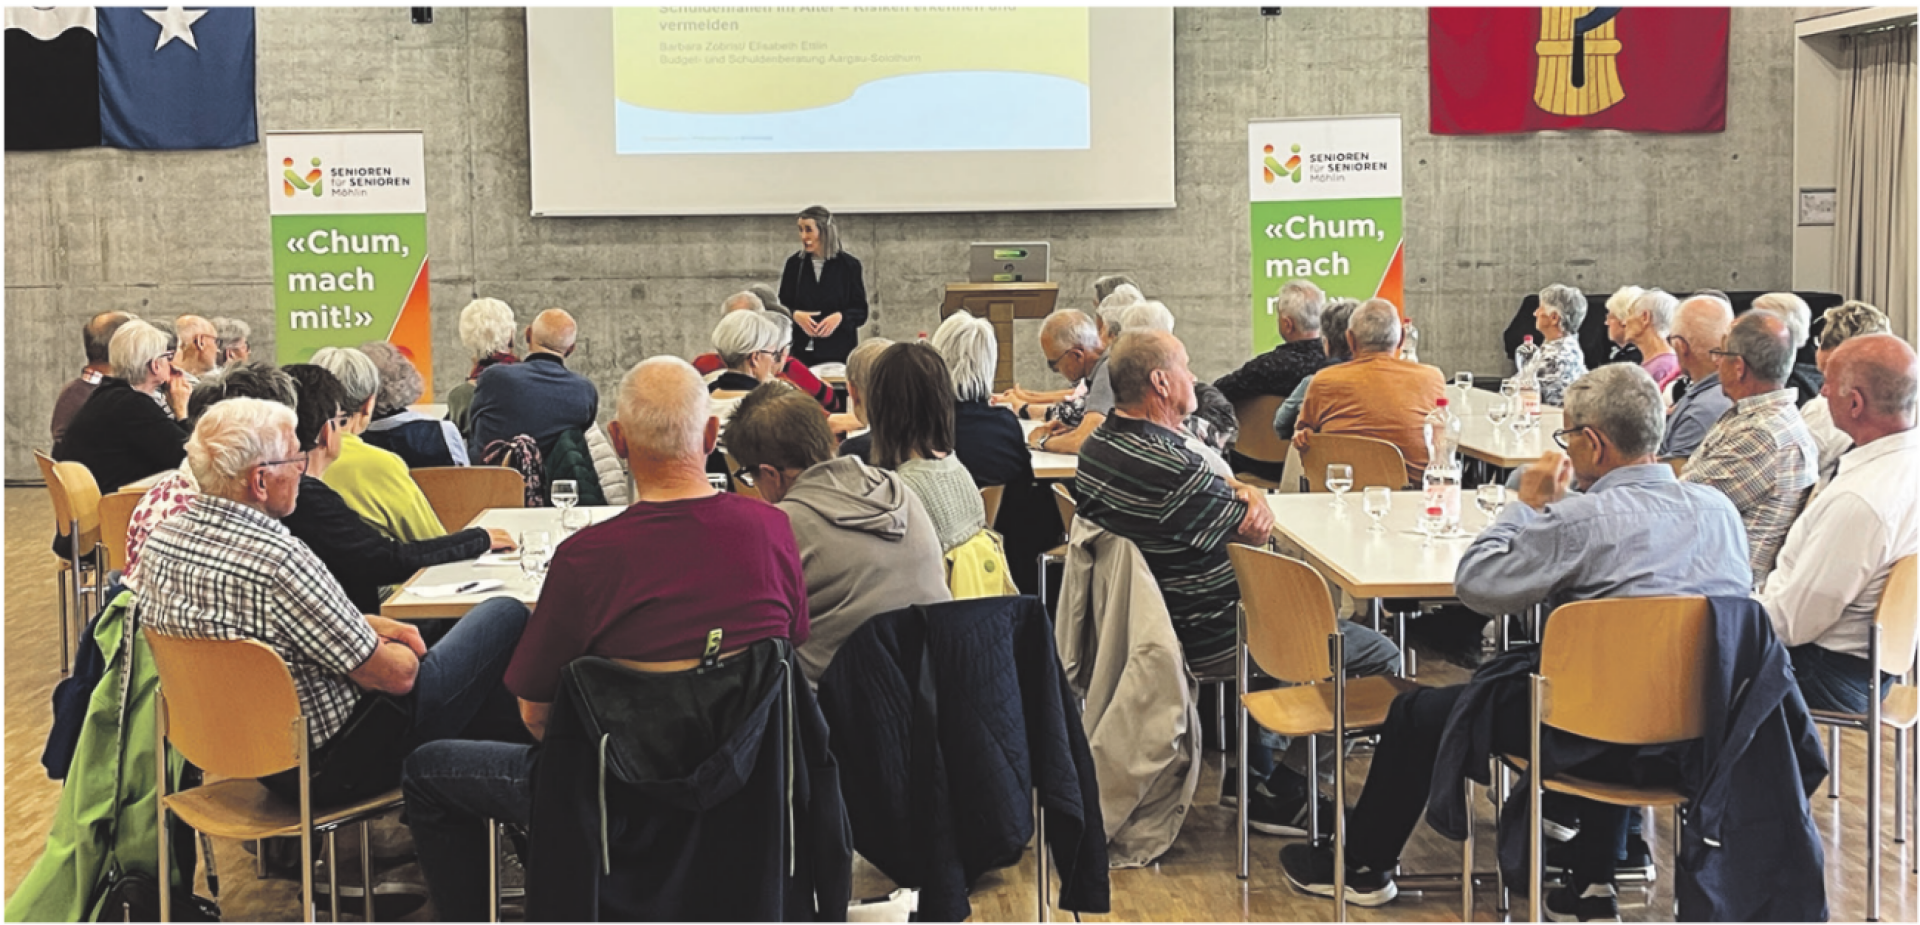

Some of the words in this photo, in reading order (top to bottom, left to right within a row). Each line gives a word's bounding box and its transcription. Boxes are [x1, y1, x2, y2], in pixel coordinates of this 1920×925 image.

[1309, 152, 1369, 163] SENIOREN
[330, 167, 391, 177] SENIOREN
[1309, 163, 1325, 172] für
[1327, 162, 1388, 172] SENIOREN
[331, 178, 347, 187] für
[349, 177, 410, 187] SENIOREN
[1309, 173, 1346, 182] Möhlin
[331, 187, 368, 197] Möhlin
[1265, 214, 1385, 242] «Chum,
[287, 229, 410, 258] «Chum,
[1266, 251, 1350, 278] mach
[288, 266, 375, 292] mach
[290, 304, 373, 330] mit!»
